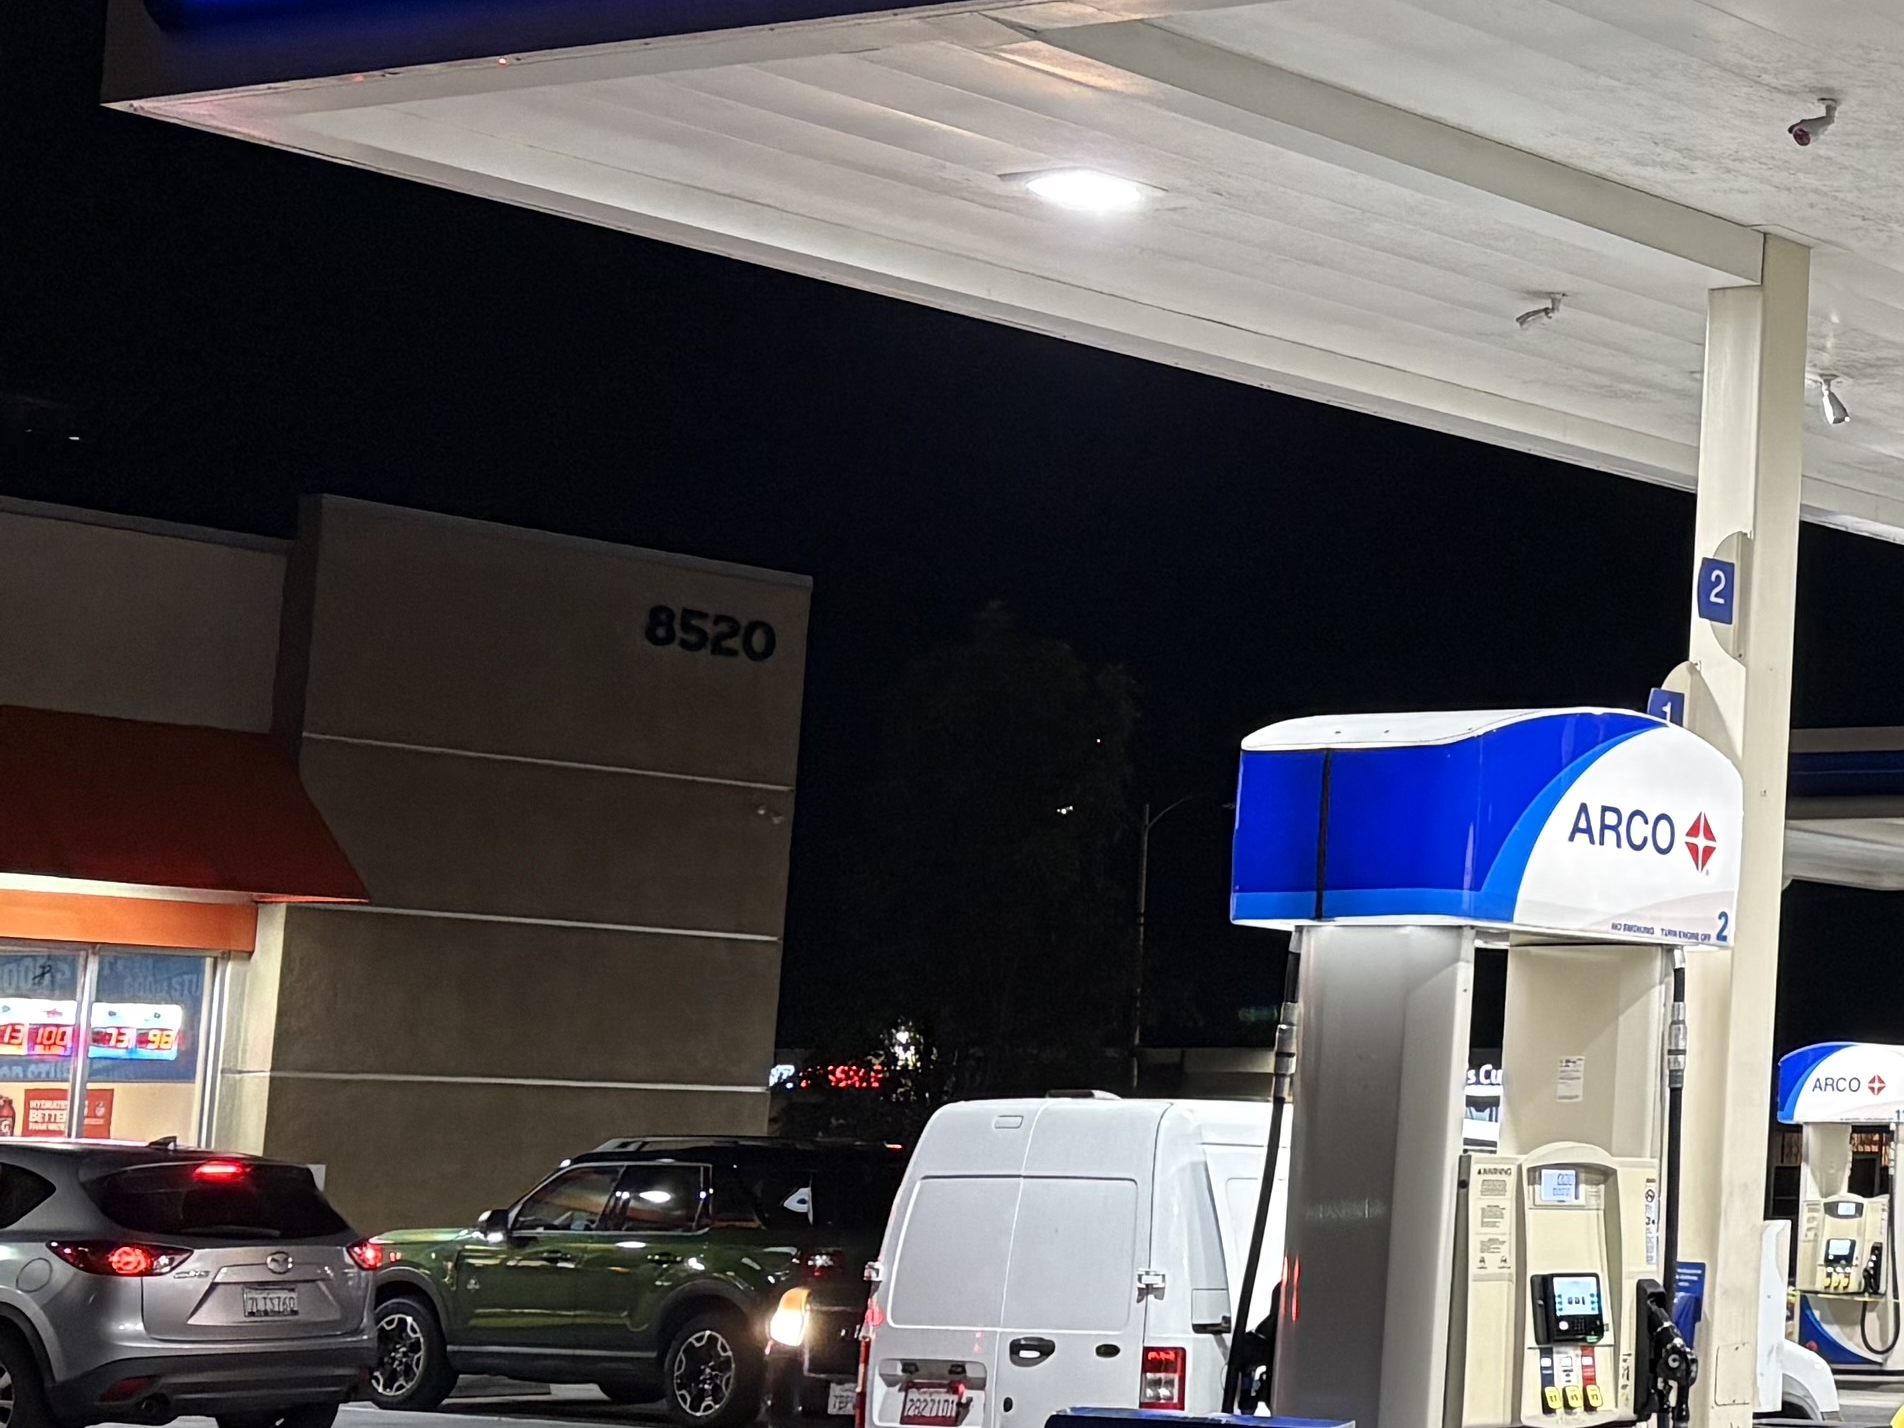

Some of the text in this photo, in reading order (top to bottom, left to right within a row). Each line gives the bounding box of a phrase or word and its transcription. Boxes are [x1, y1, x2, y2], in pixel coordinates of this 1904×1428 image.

[1709, 569, 1727, 605] 2
[645, 605, 776, 662] 8520
[1568, 802, 1676, 855] ARCO
[1716, 911, 1729, 942] 2
[1812, 1077, 1861, 1092] ARCO
